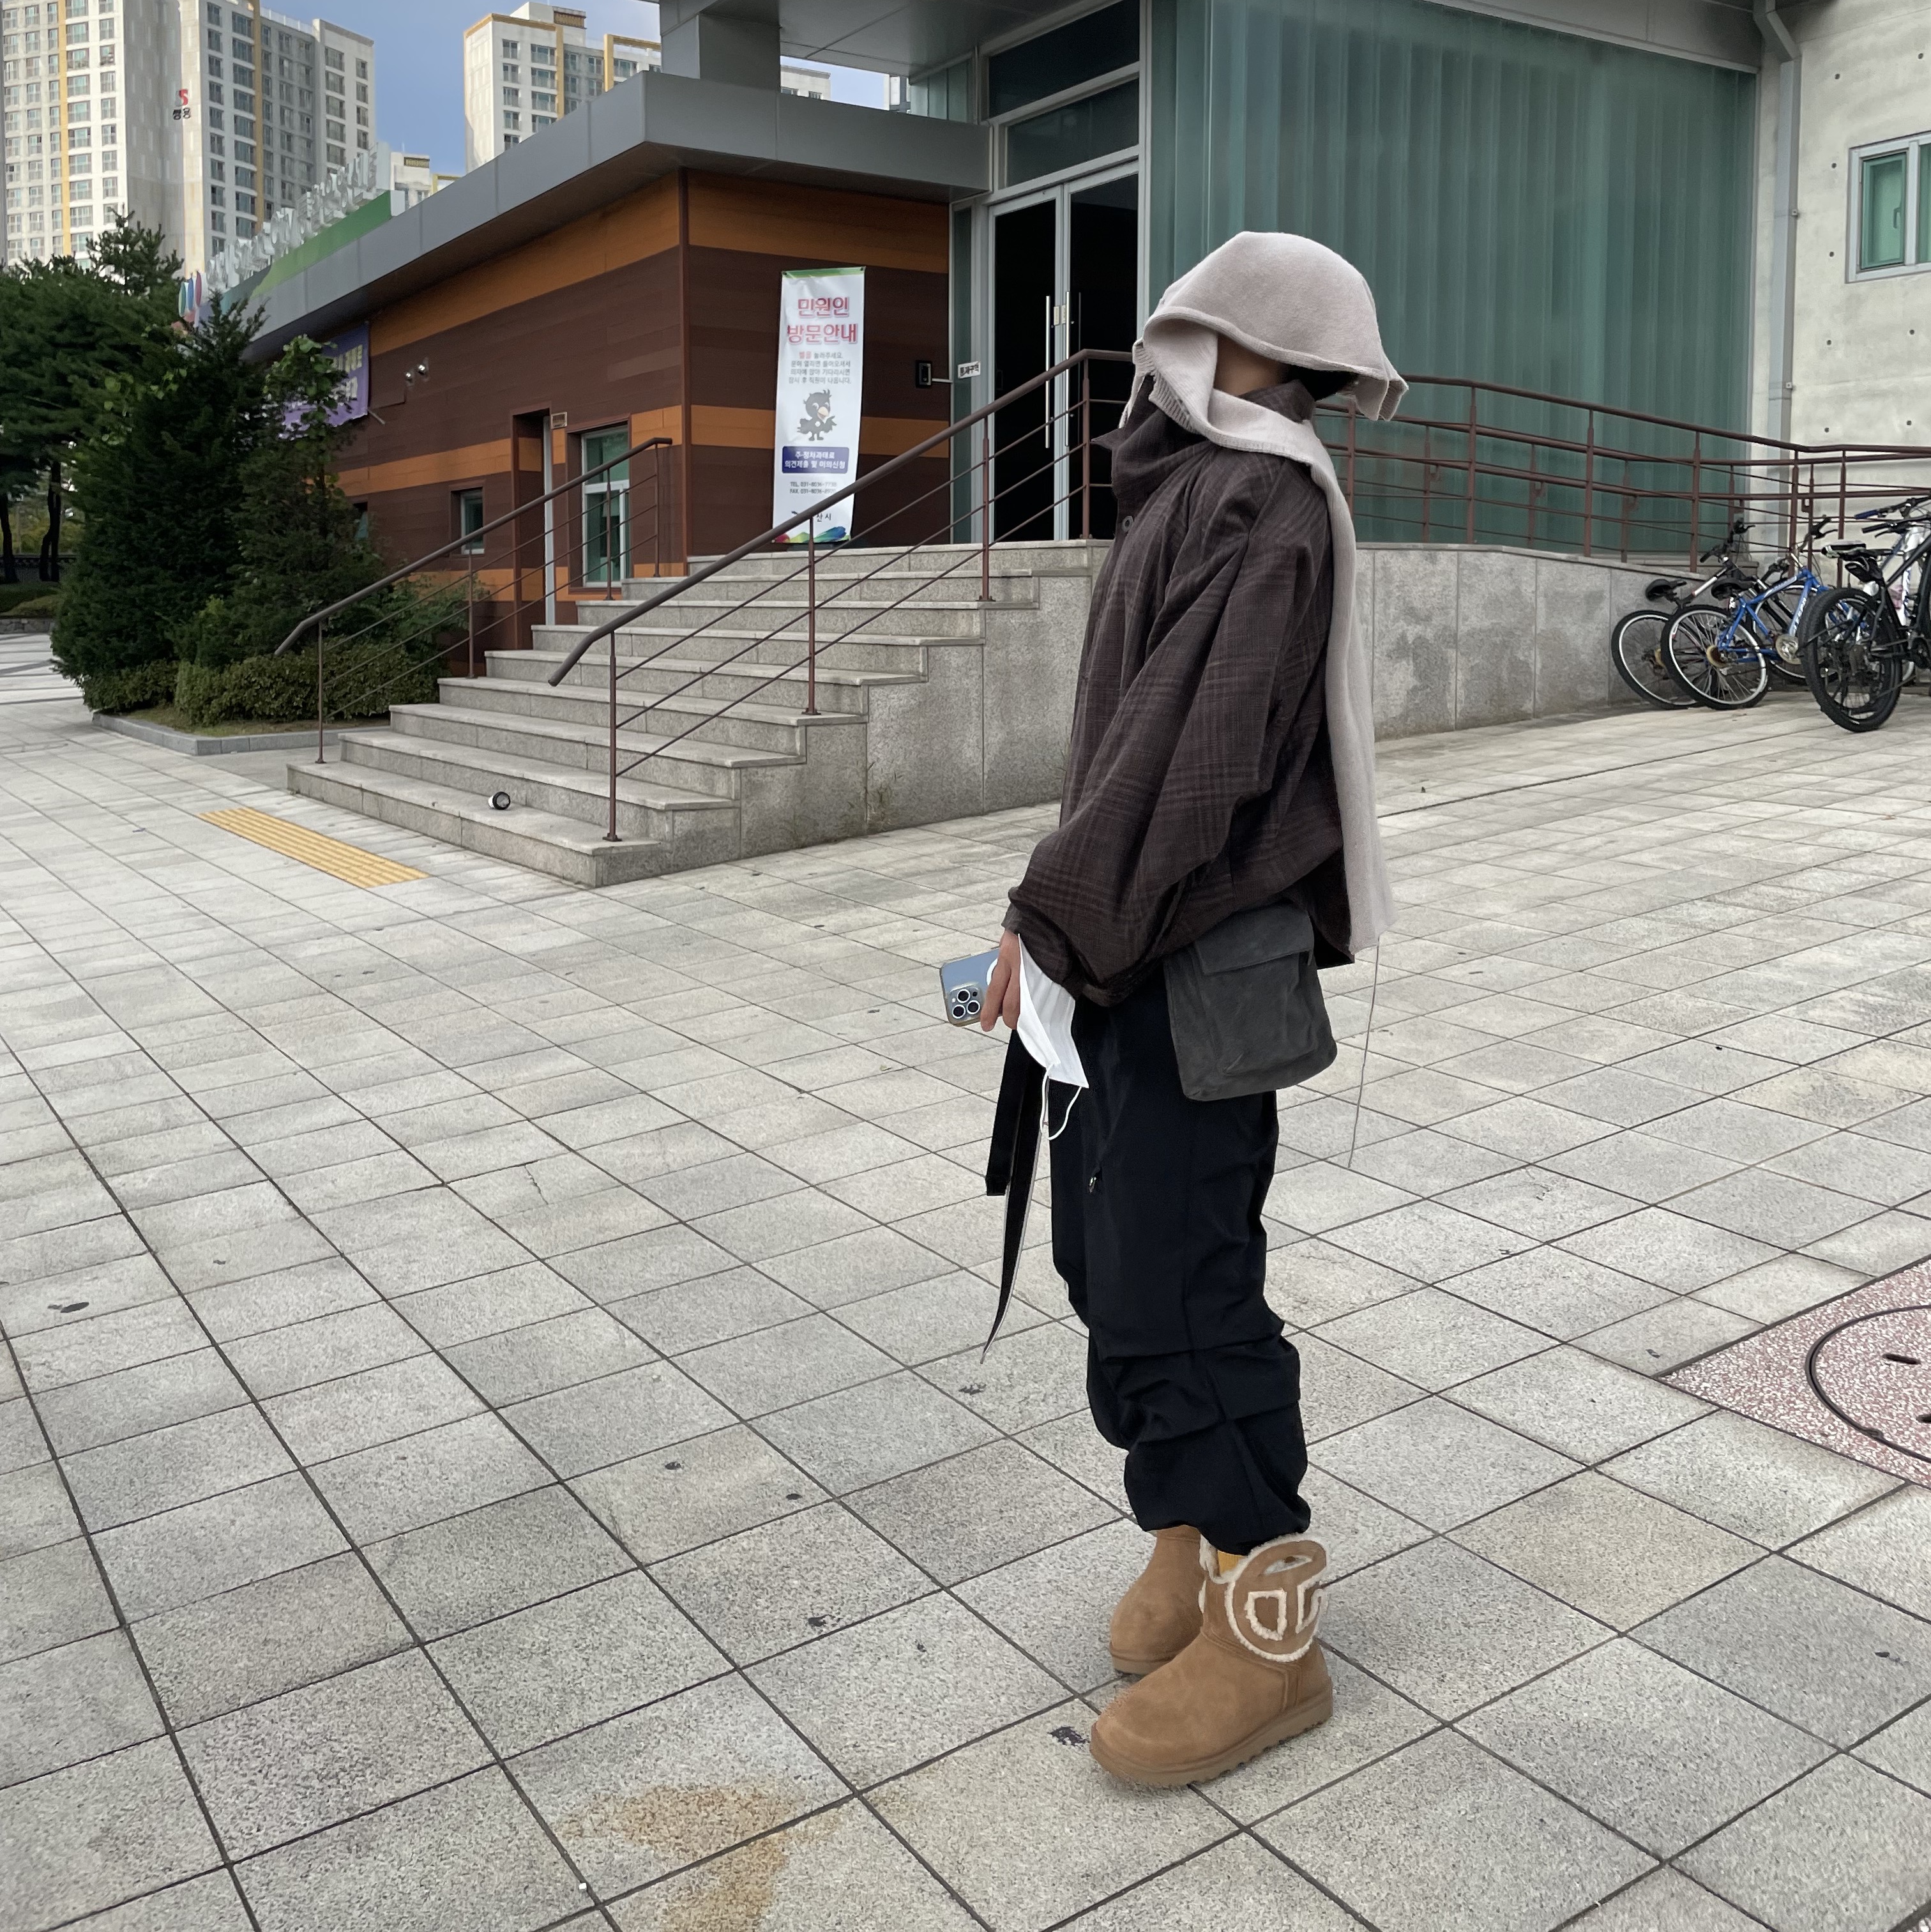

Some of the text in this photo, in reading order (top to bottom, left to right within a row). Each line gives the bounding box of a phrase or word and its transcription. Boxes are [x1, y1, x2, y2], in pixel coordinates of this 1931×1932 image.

[173, 108, 191, 120] 쌍용
[798, 297, 849, 317] 민원인
[787, 324, 858, 343] 방문안내
[819, 460, 845, 469] 이의신청
